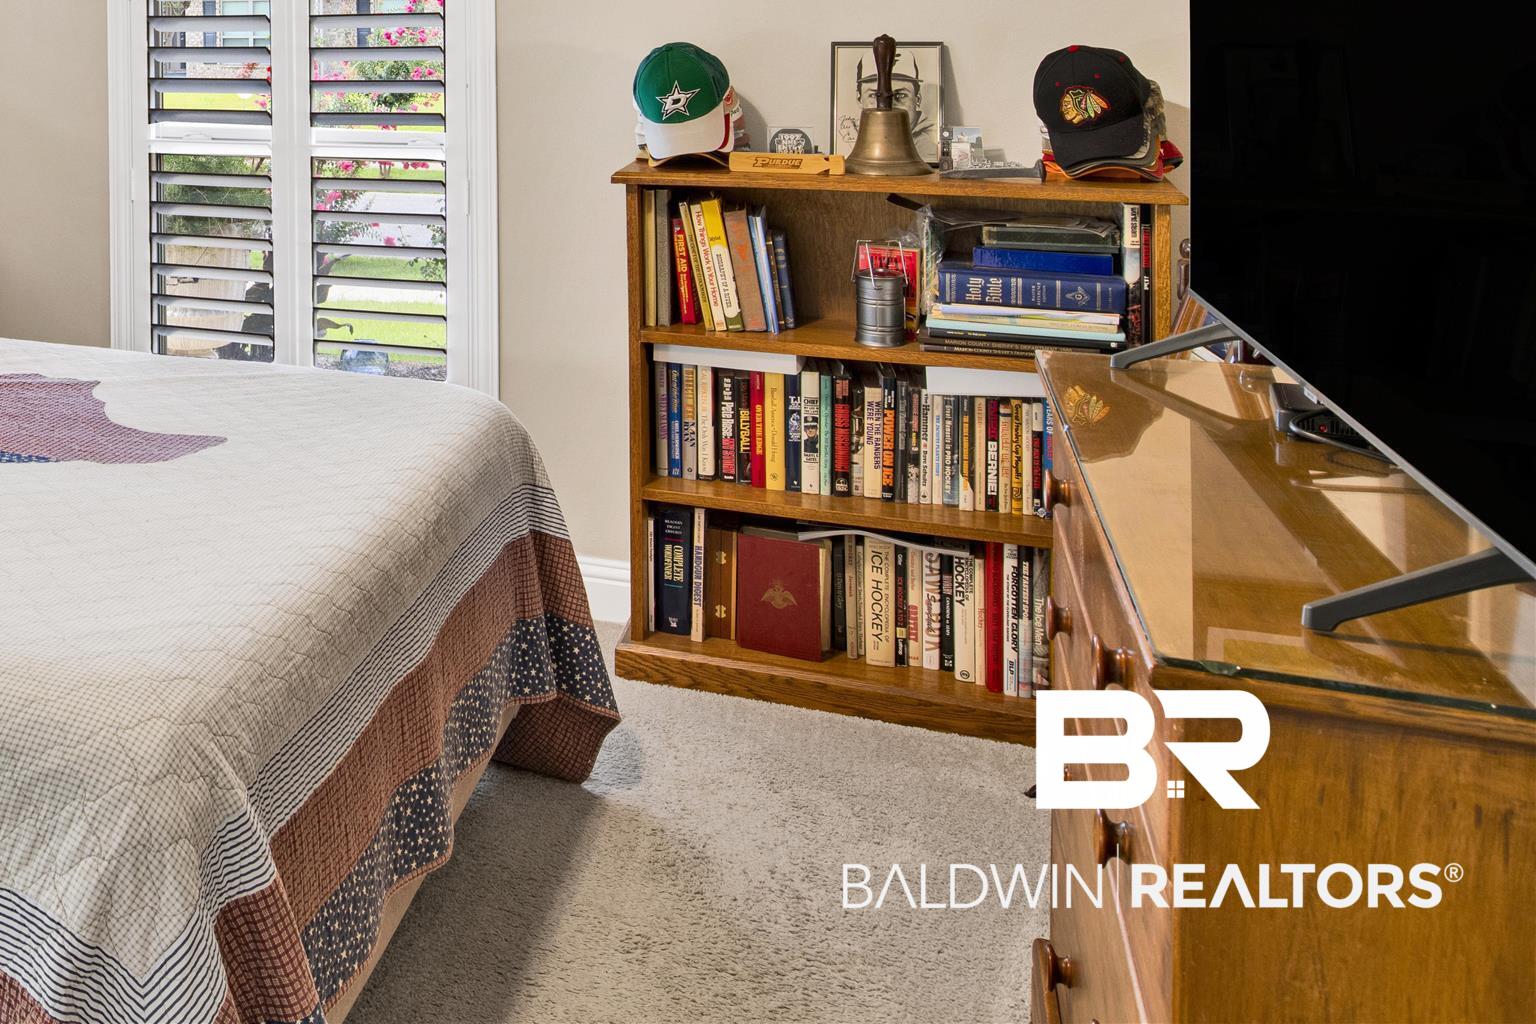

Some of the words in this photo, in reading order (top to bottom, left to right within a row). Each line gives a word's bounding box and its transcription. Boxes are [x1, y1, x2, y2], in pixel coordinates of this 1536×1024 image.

[753, 157, 803, 169] PURDUE
[695, 211, 703, 226] How
[677, 234, 686, 257] FIRST
[698, 227, 707, 248] Things
[678, 258, 687, 272] AID
[702, 248, 711, 265] Work
[707, 272, 716, 286] Your
[965, 277, 985, 302] Holy
[710, 286, 720, 307] Home
[985, 278, 1003, 304] Bible
[722, 402, 735, 418] Pete
[755, 404, 763, 423] OVER
[835, 404, 849, 427] GROSS
[1012, 403, 1022, 421] Great
[739, 410, 750, 453] BILLYBALL
[755, 423, 763, 437] THE
[882, 409, 894, 450] POWER
[922, 404, 930, 441] Hammer
[1012, 421, 1022, 443] Stanley
[755, 438, 763, 455] EDGE
[1012, 444, 1022, 454] Cup
[882, 450, 894, 465] ON
[988, 441, 997, 495] BERNIE!
[1012, 455, 1022, 480] Playoffs
[882, 467, 894, 487] ICE
[664, 544, 673, 581] WORDFINDER
[673, 545, 684, 582] COMPLETE
[693, 545, 703, 580] HANDGUN
[871, 550, 882, 574] ICE
[954, 556, 965, 606] HOCKEY
[693, 581, 703, 608] DIGEST
[964, 593, 970, 601] OF
[871, 578, 882, 642] HOCKEY
[927, 593, 937, 633] Sawchuk
[1035, 597, 1044, 614] The
[1034, 614, 1043, 627] Ice
[884, 635, 889, 643] OF
[1034, 627, 1043, 645] Men
